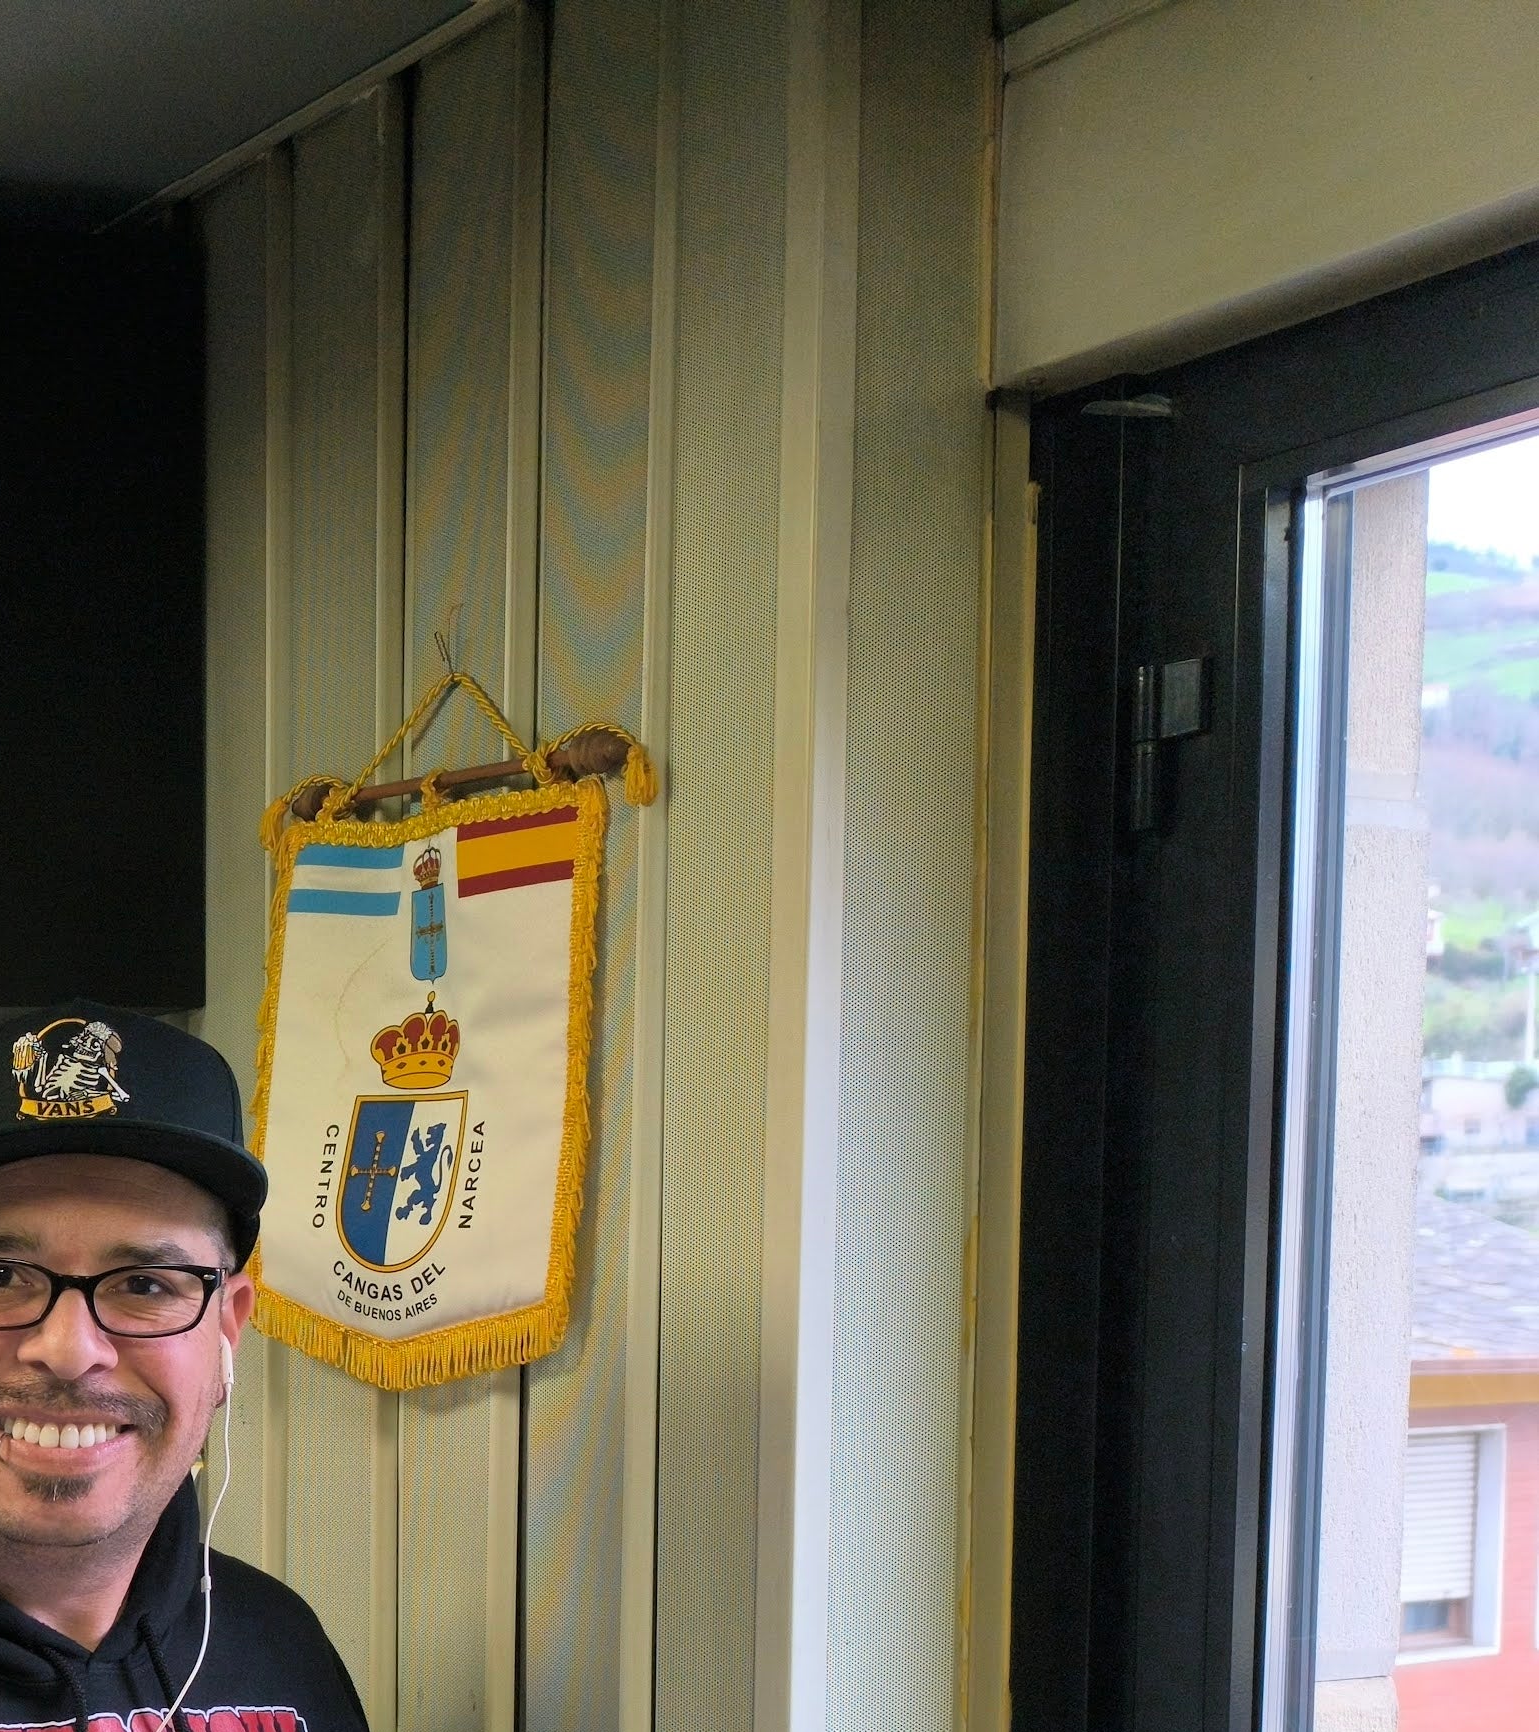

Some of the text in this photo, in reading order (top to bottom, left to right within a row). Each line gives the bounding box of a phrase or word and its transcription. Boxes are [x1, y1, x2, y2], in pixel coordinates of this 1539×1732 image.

[36, 1100, 94, 1115] VANS
[312, 1121, 485, 1302] CENTRO CANGAS DEL NARCEA
[337, 1289, 438, 1321] DE BUENOS AIRES
